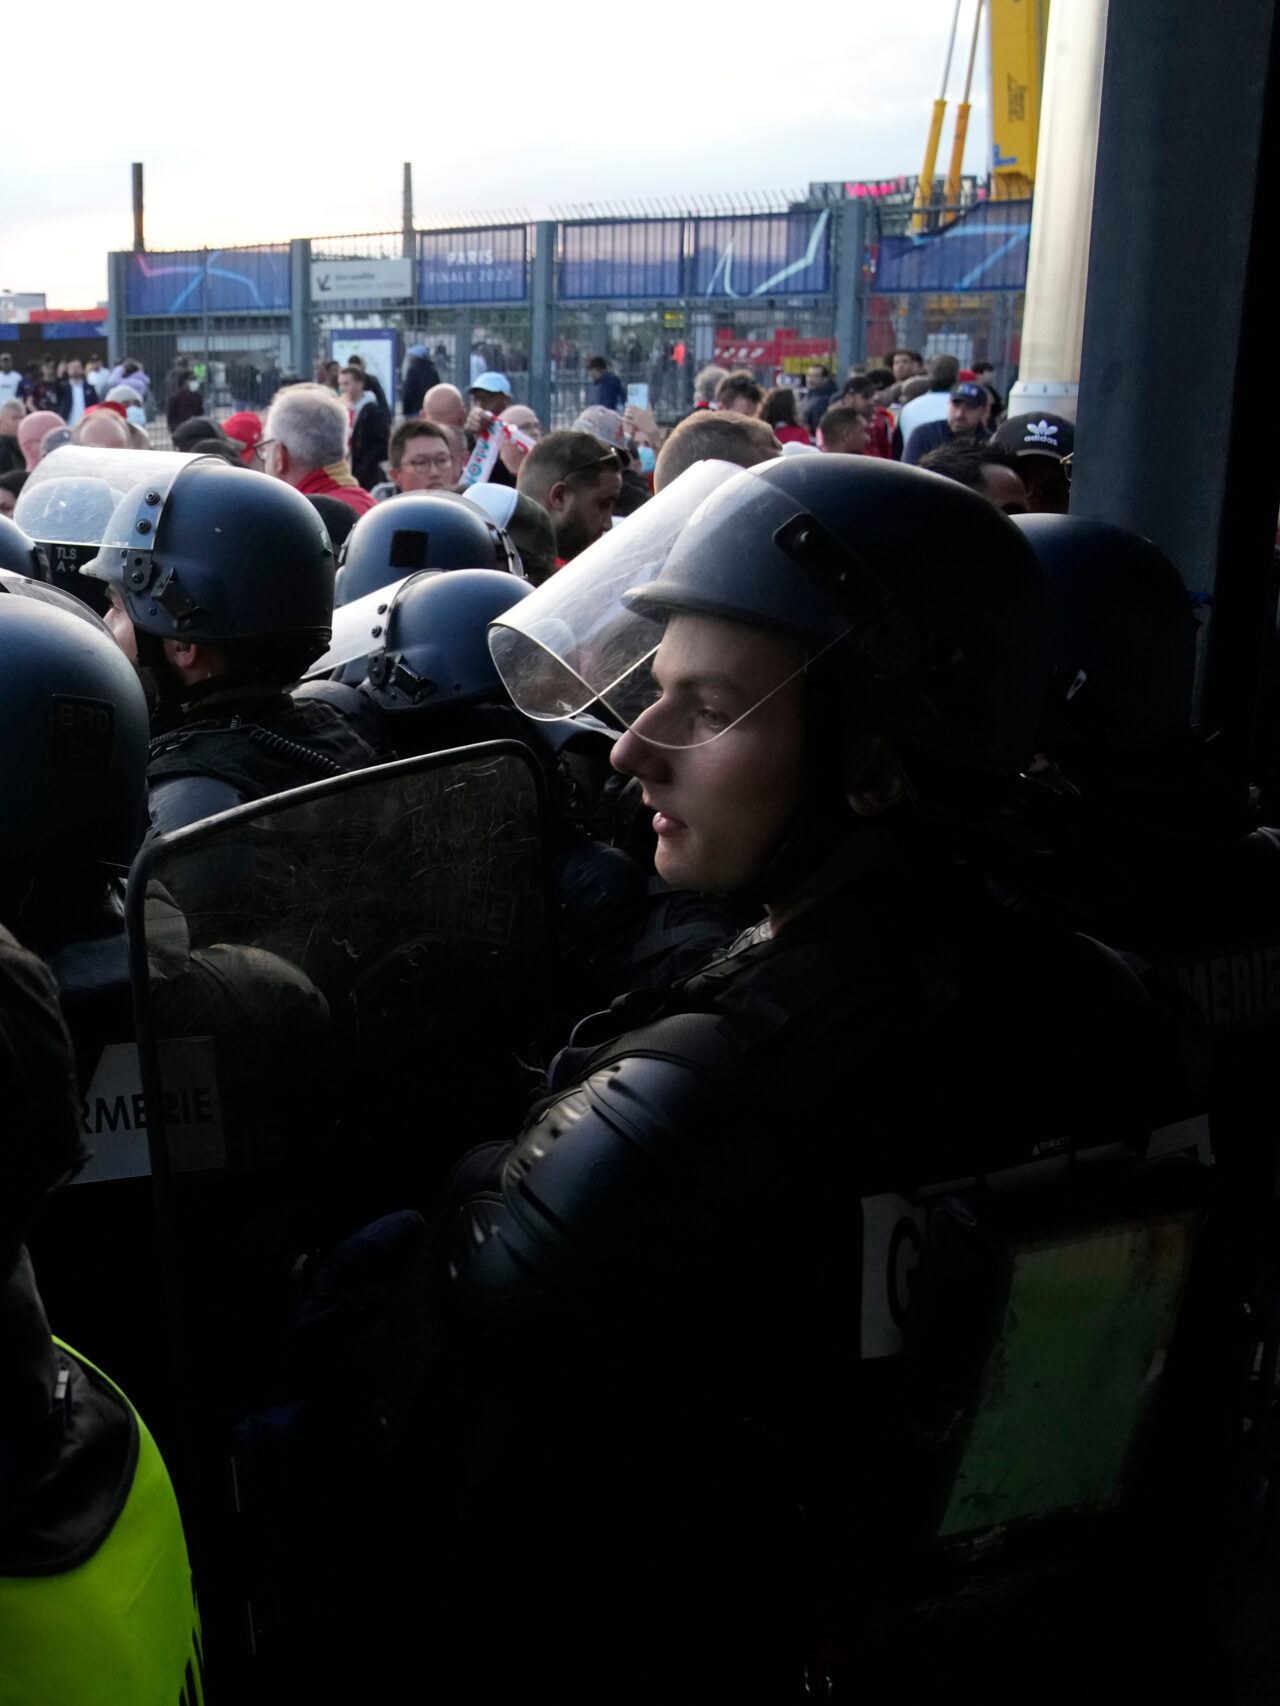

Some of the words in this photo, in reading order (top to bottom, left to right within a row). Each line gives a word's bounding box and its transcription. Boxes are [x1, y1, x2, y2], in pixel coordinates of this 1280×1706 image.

[446, 250, 494, 267] PARIS
[428, 270, 474, 285] FINALE
[478, 268, 514, 283] 2022
[1023, 434, 1058, 447] adidas
[55, 546, 78, 561] TLS
